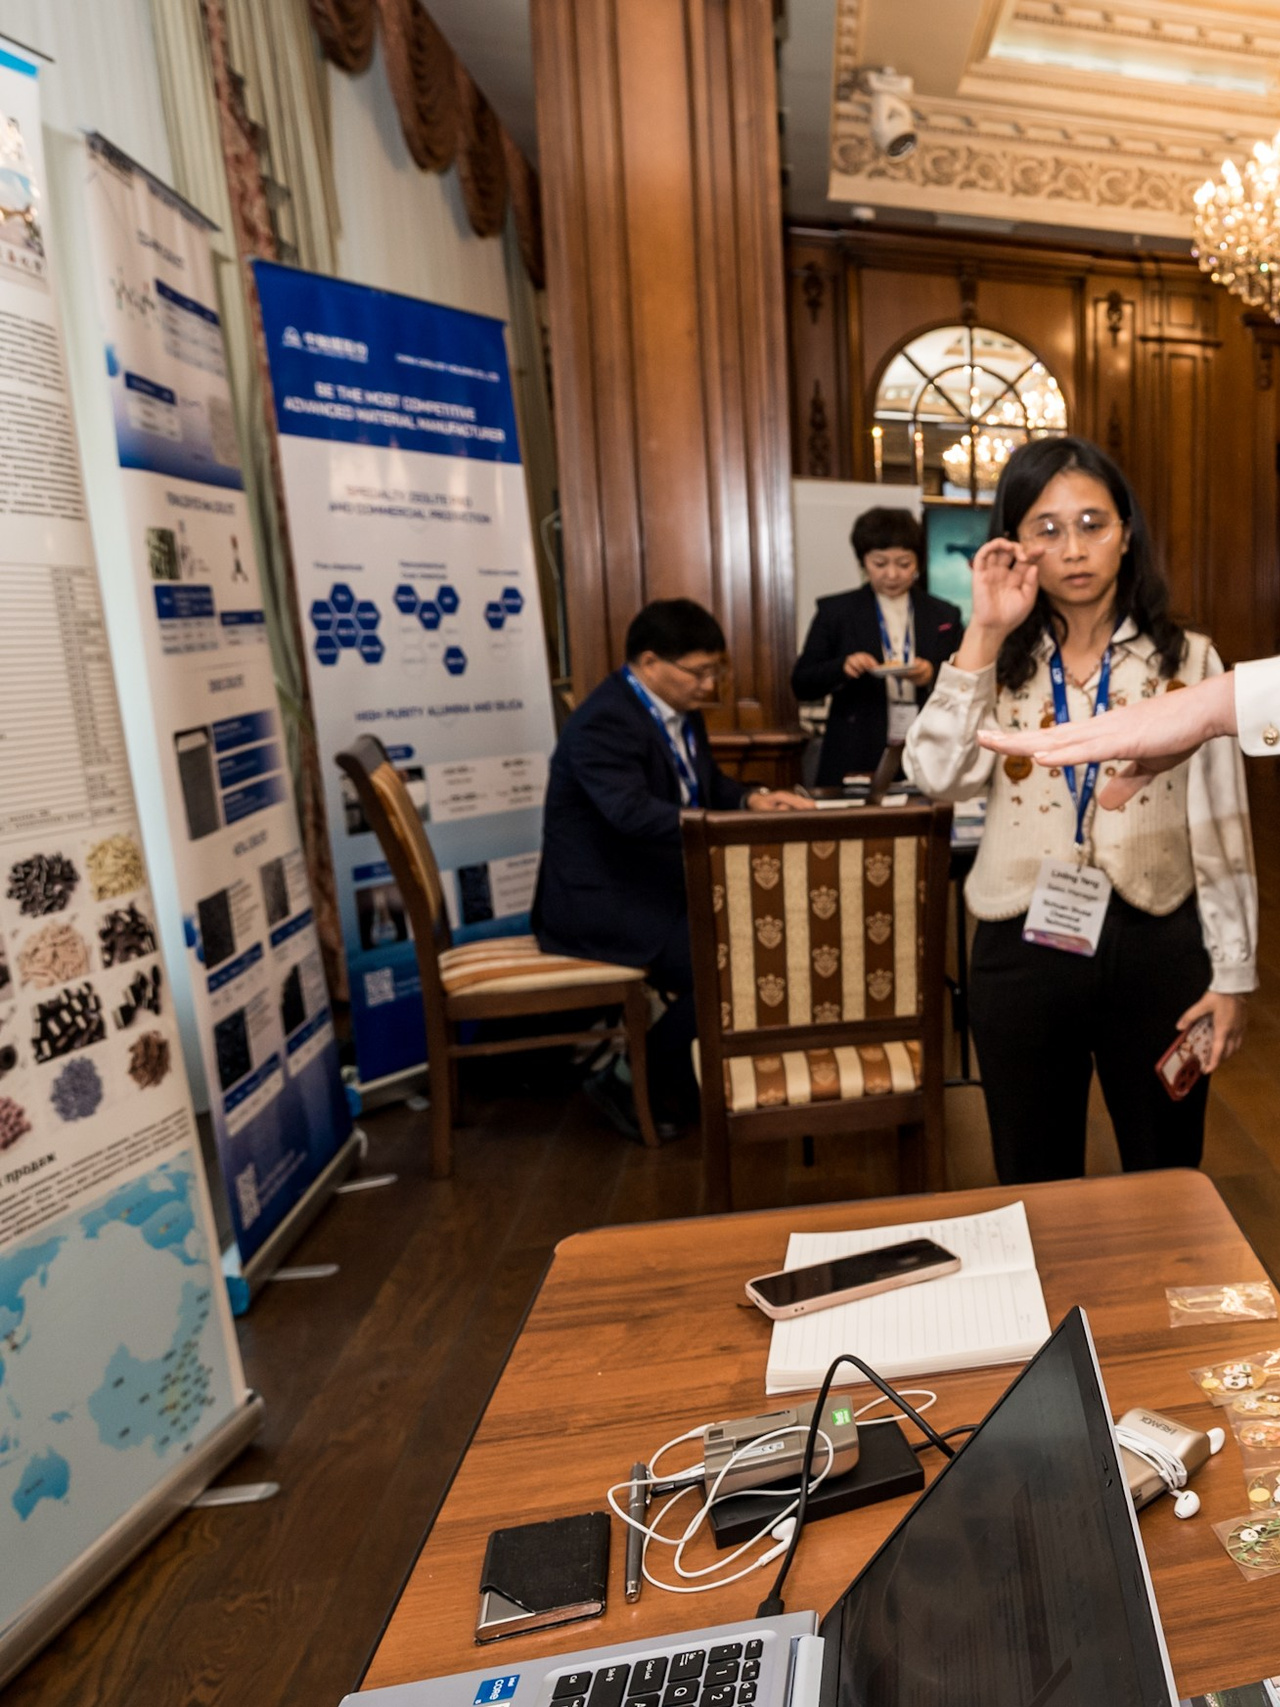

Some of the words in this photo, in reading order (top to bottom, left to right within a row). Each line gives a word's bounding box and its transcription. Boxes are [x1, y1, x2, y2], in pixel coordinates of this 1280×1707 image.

[402, 396, 477, 422] COMPETITIVE
[674, 1687, 688, 1698] Q
[711, 1693, 723, 1701] 2
